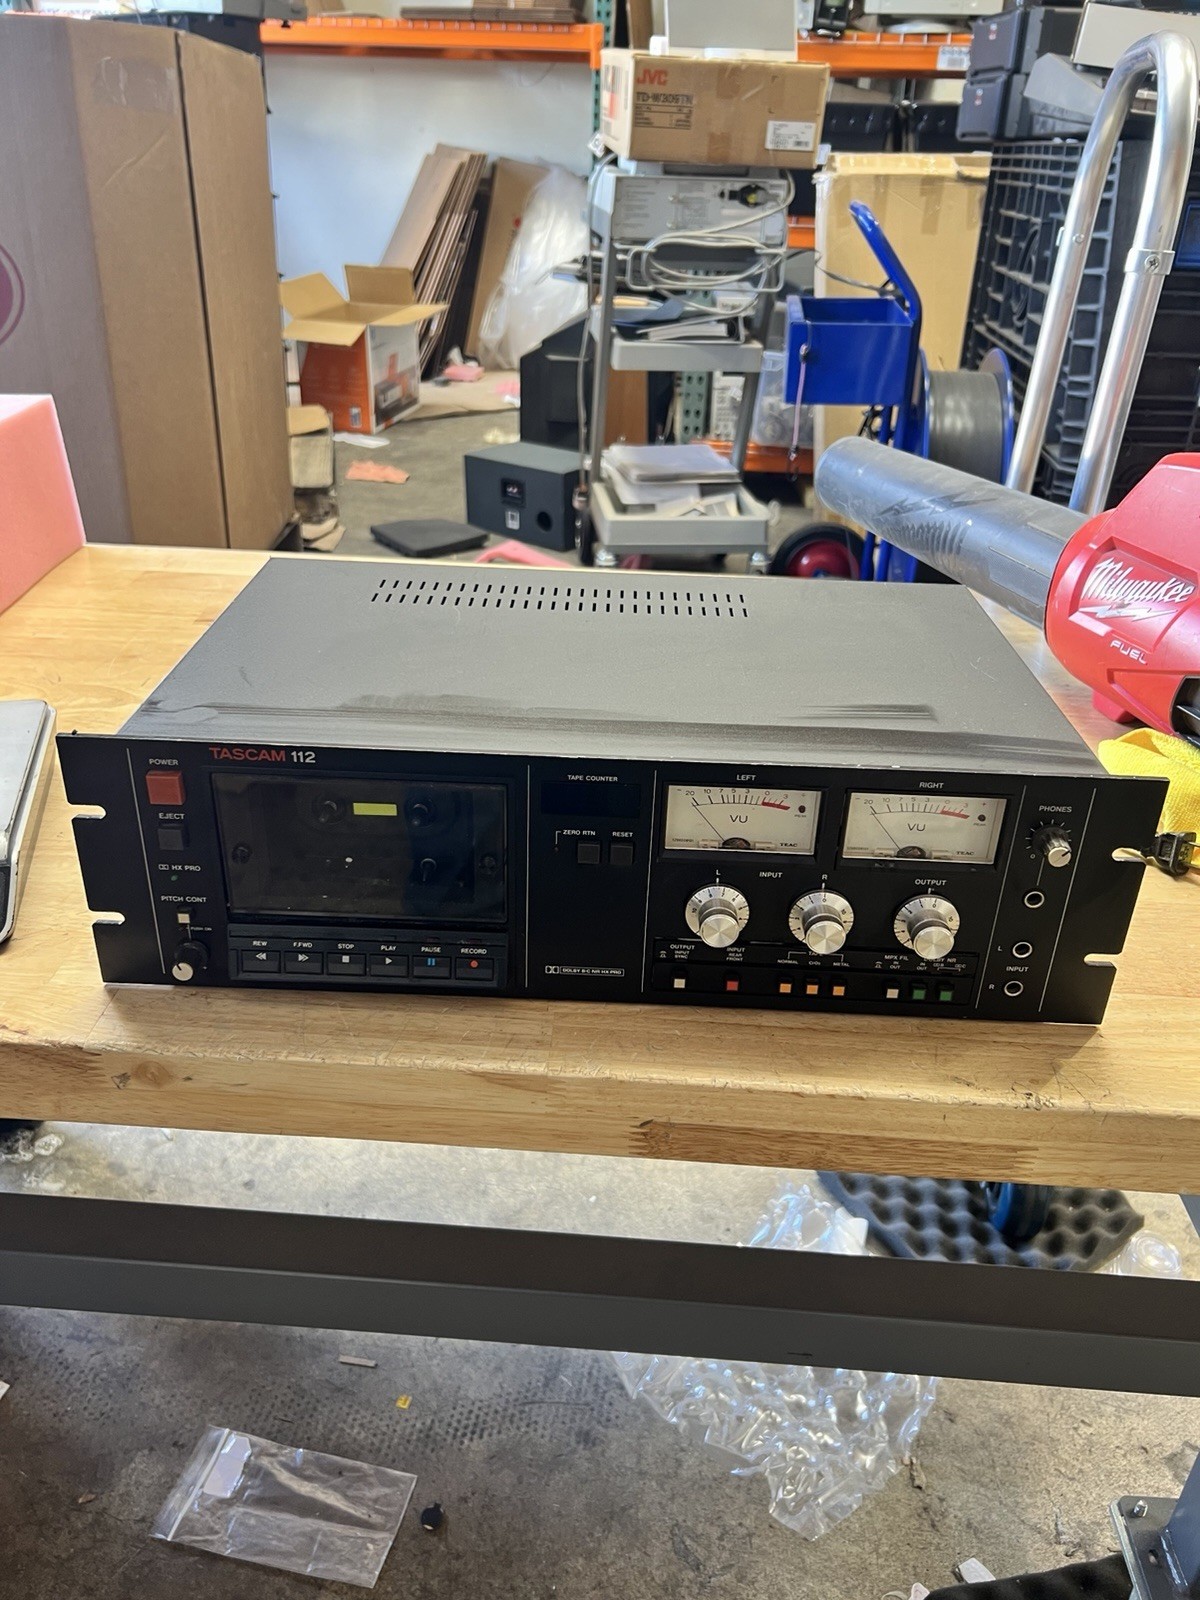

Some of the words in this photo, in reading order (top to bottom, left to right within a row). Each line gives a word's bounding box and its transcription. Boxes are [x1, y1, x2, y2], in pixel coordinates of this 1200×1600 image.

[637, 68, 668, 86] JVC
[1080, 557, 1195, 603] Milwaukee
[1110, 640, 1148, 665] FUEL
[209, 747, 286, 762] TASCAM
[291, 751, 316, 764] 112
[149, 758, 179, 766] POWER
[1038, 805, 1072, 813] PHONES
[730, 815, 748, 824] VU
[907, 823, 926, 831] VU
[759, 871, 783, 879] INPUT
